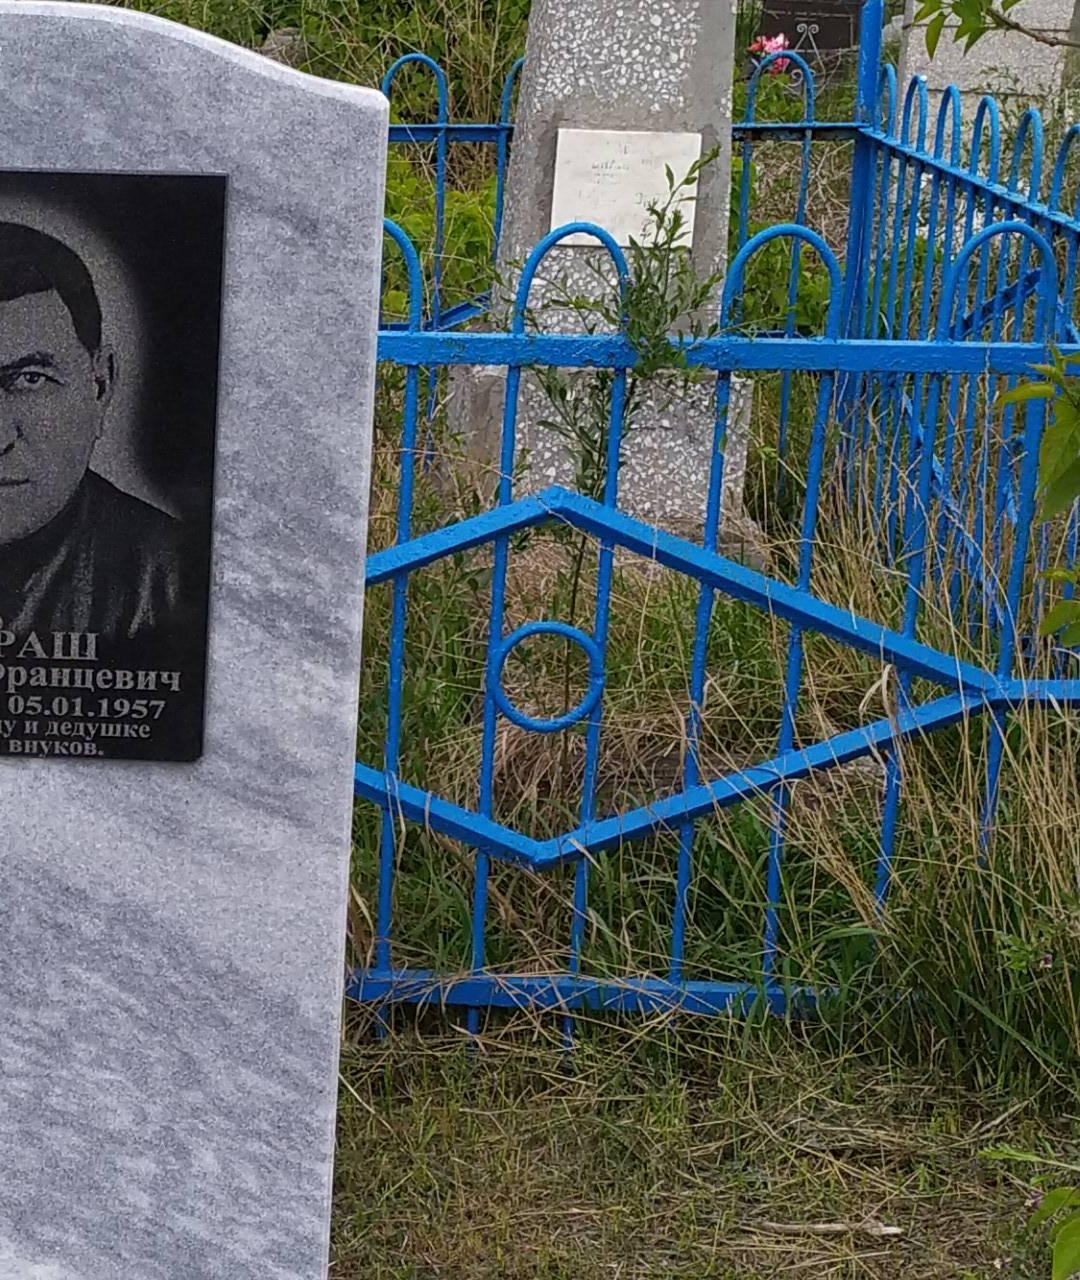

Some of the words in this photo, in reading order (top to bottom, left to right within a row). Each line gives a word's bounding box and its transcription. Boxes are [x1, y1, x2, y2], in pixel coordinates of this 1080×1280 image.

[7, 695, 167, 720] 05.01.1957
[23, 720, 39, 734] и
[45, 720, 152, 741] дедушке
[9, 739, 105, 758] внуков.
